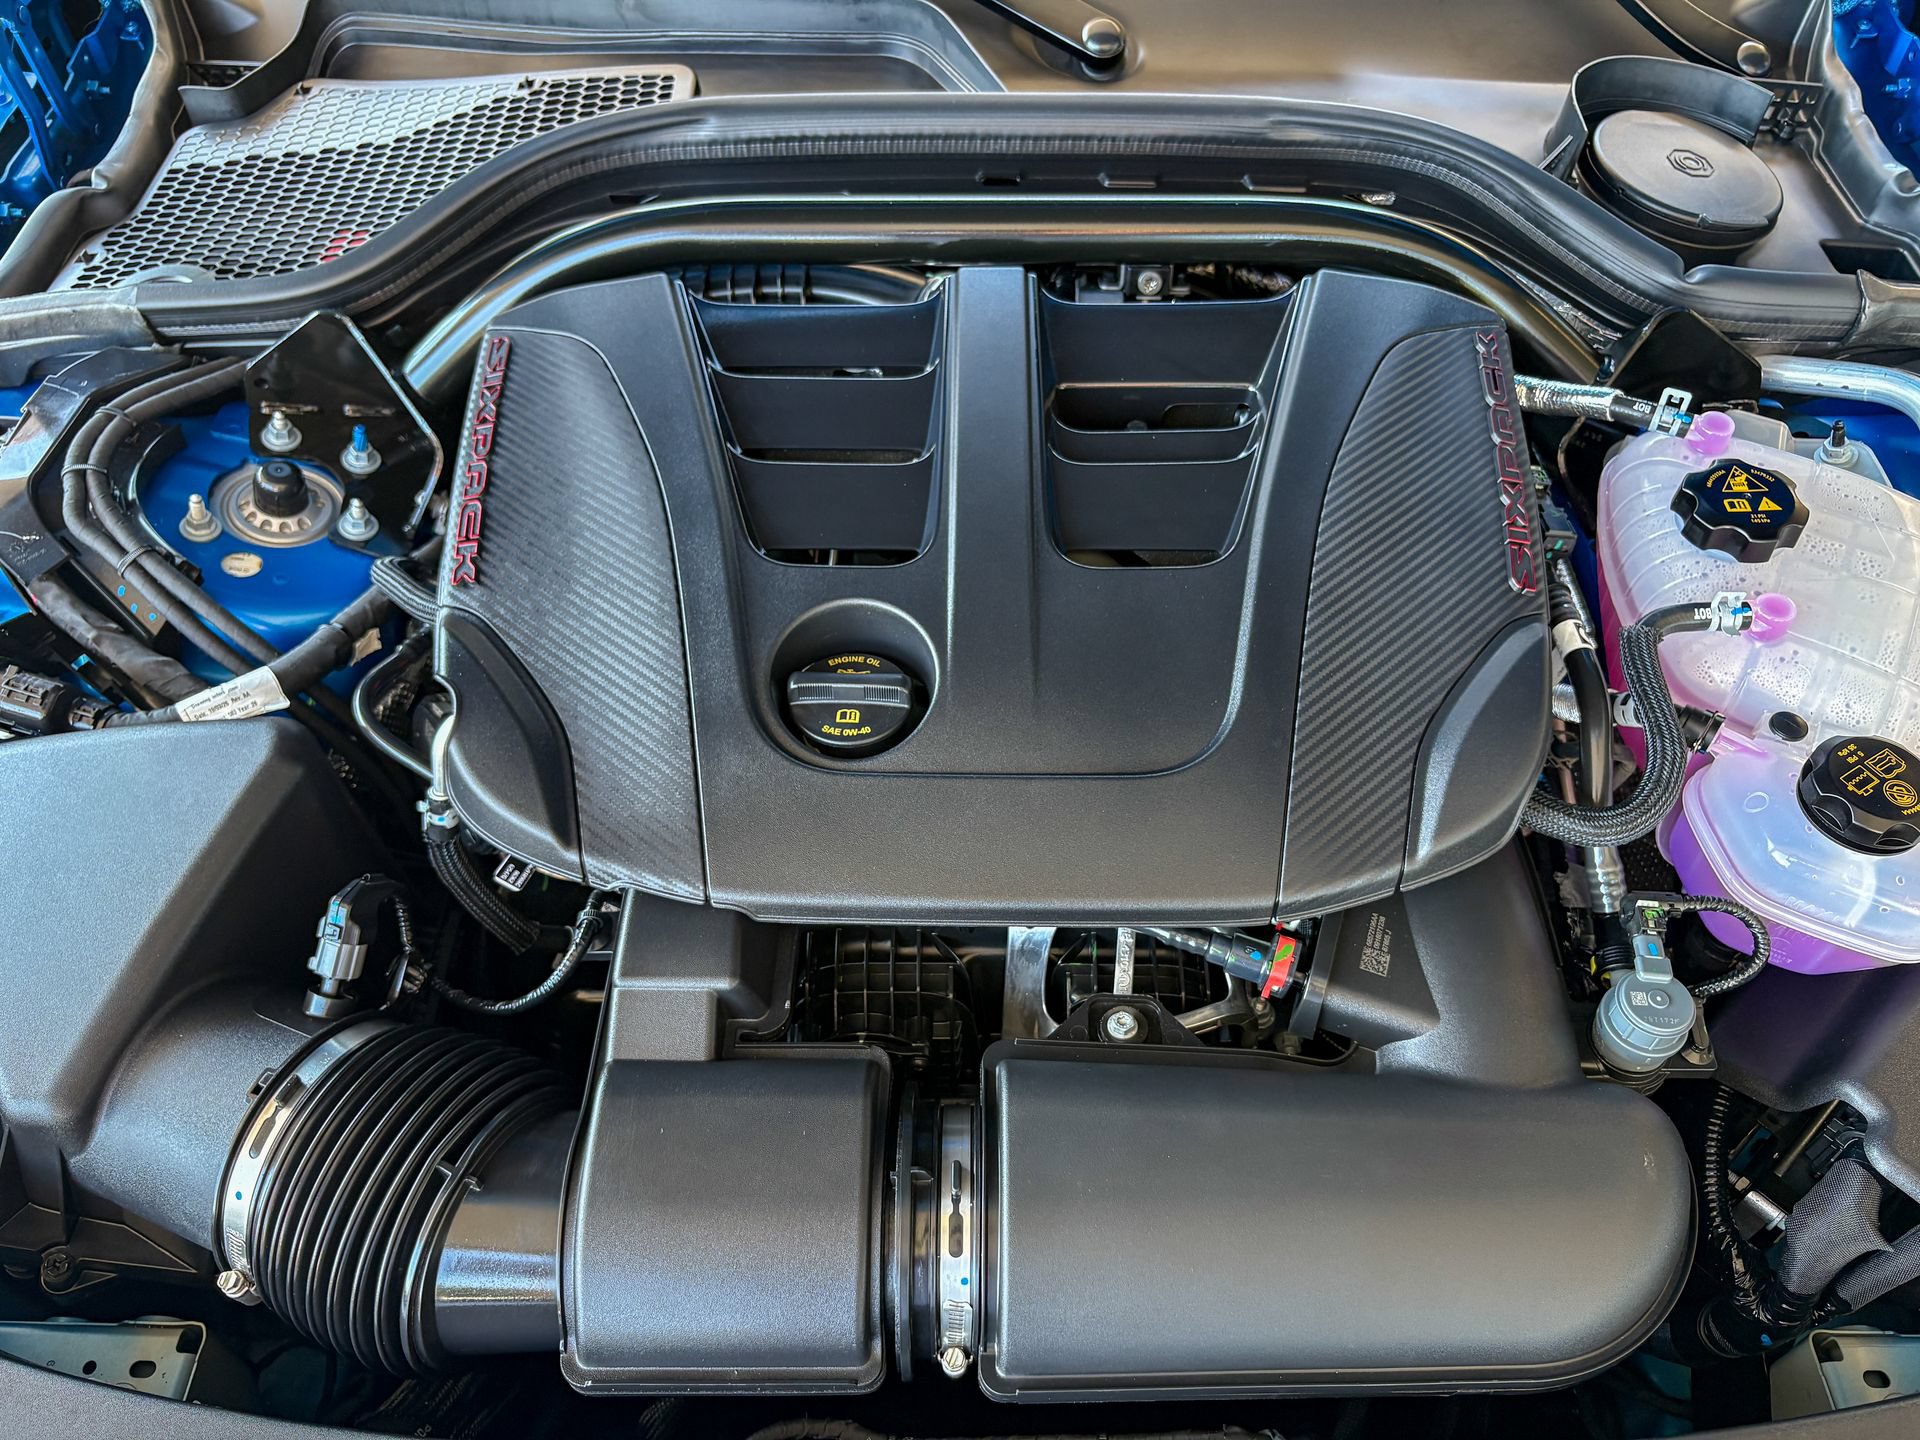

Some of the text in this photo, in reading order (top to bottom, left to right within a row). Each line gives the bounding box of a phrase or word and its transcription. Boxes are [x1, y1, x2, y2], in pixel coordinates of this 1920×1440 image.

[1633, 401, 1652, 413] BOT
[1694, 607, 1713, 620] BOT
[828, 656, 881, 668] ENGINE OIL
[822, 725, 873, 737] SAE 0W-40
